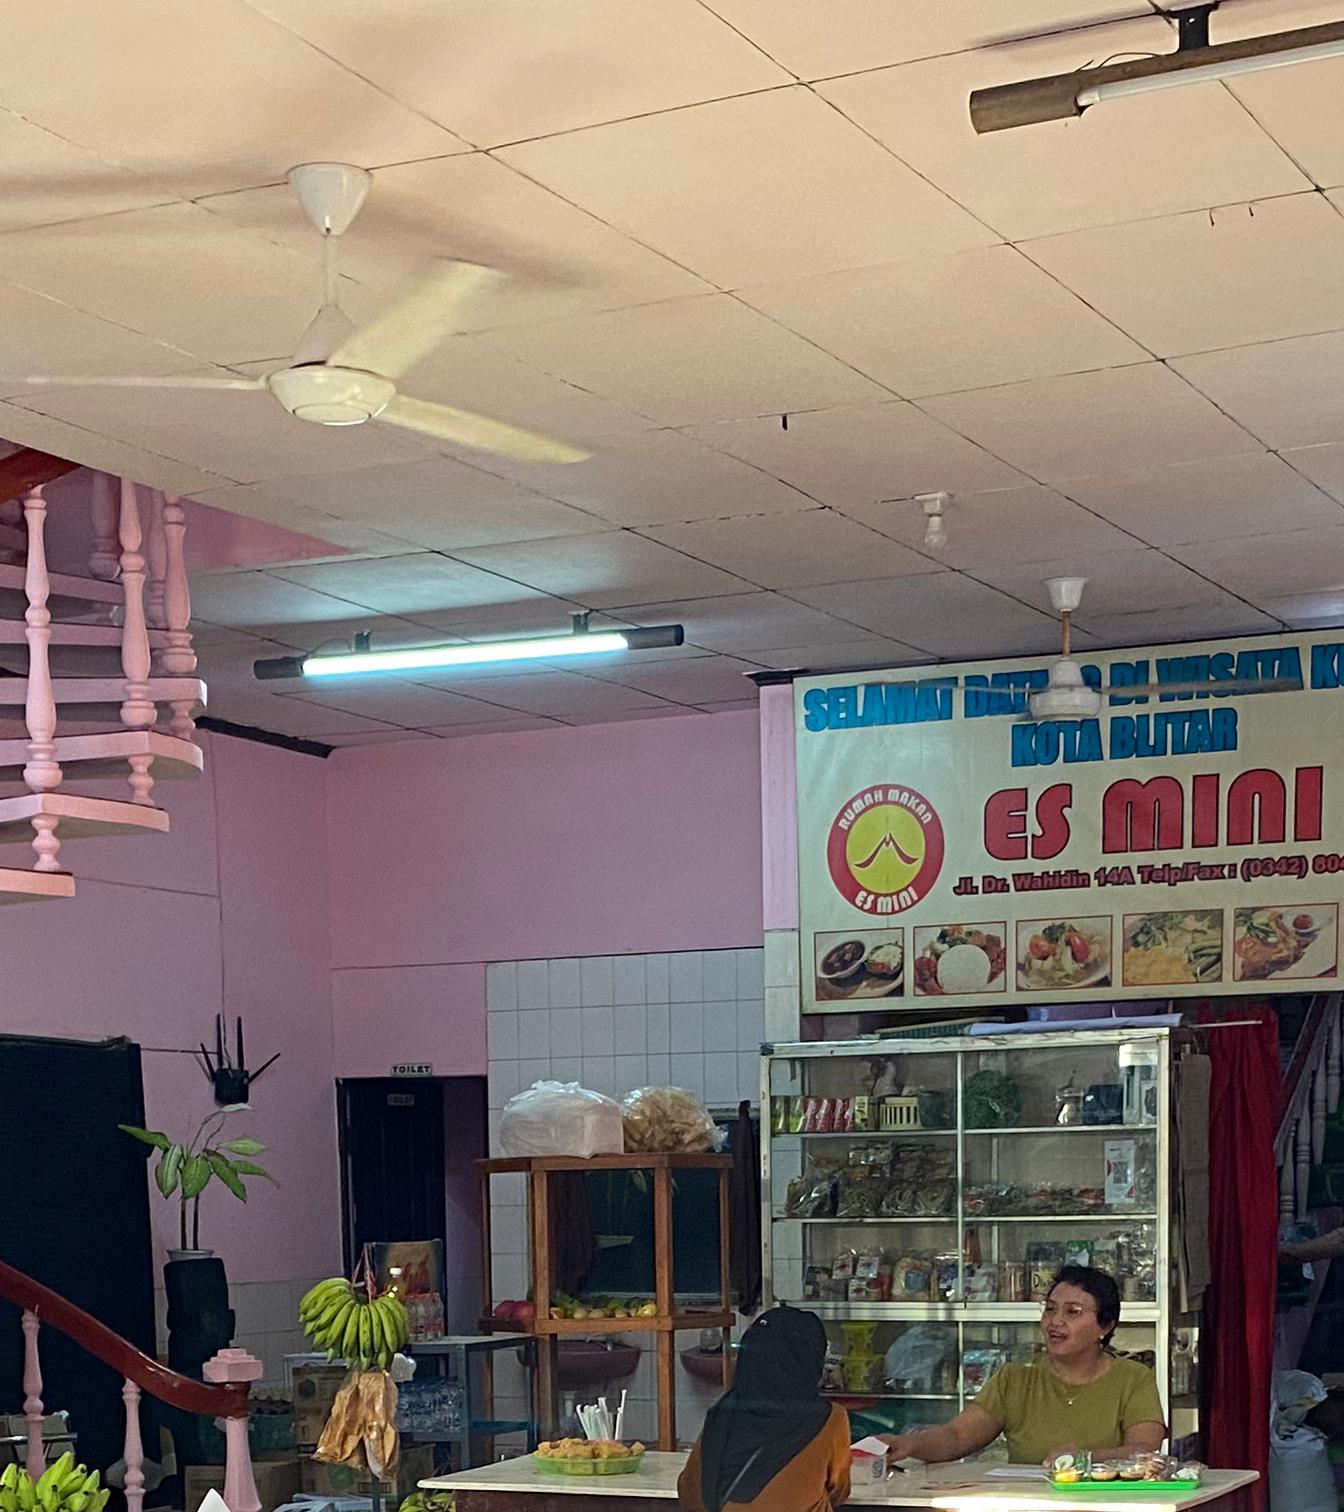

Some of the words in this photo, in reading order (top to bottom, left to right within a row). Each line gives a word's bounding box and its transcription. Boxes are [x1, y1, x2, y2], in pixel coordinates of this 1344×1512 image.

[803, 676, 959, 733] SELAMAT
[1109, 661, 1150, 707] DI
[1155, 646, 1305, 703] WISATA
[1011, 717, 1104, 768] KOTA
[1109, 706, 1238, 760] BLITAR
[838, 789, 884, 831] RUMAH
[887, 788, 933, 825] MAKAN
[982, 782, 1074, 861] ES
[1102, 765, 1324, 855] MINI
[982, 874, 1010, 895] Dr.
[1012, 869, 1091, 892] Wahidin
[1094, 866, 1136, 886] 14A
[1241, 854, 1309, 883] (0342)
[855, 890, 875, 911] ES
[877, 886, 919, 914] MINI
[392, 1065, 431, 1074] TOILET
